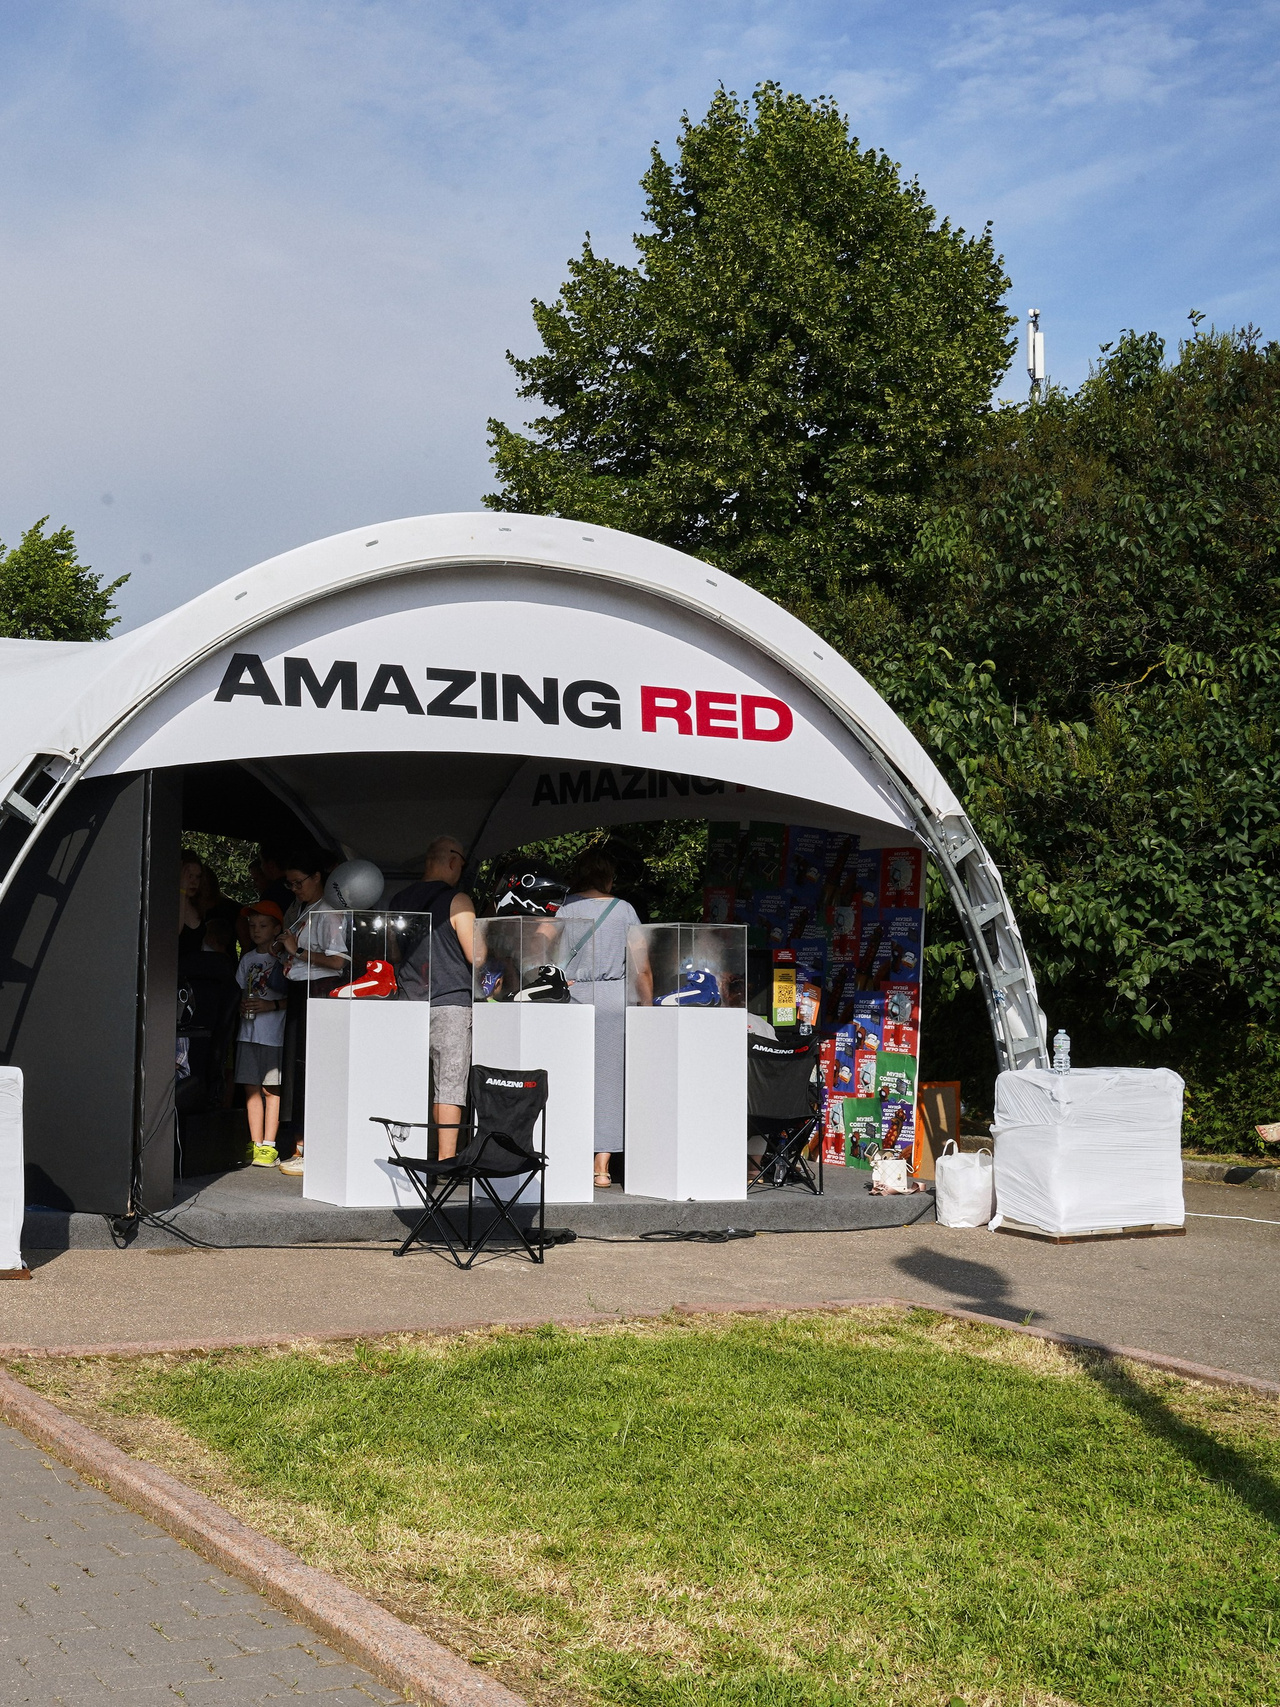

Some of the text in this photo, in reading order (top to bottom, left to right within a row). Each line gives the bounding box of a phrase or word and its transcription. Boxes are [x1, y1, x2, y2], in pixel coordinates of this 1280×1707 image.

[213, 653, 794, 743] AMAZING RED
[752, 1044, 794, 1054] AMAZING
[486, 1078, 523, 1088] AMAZING
